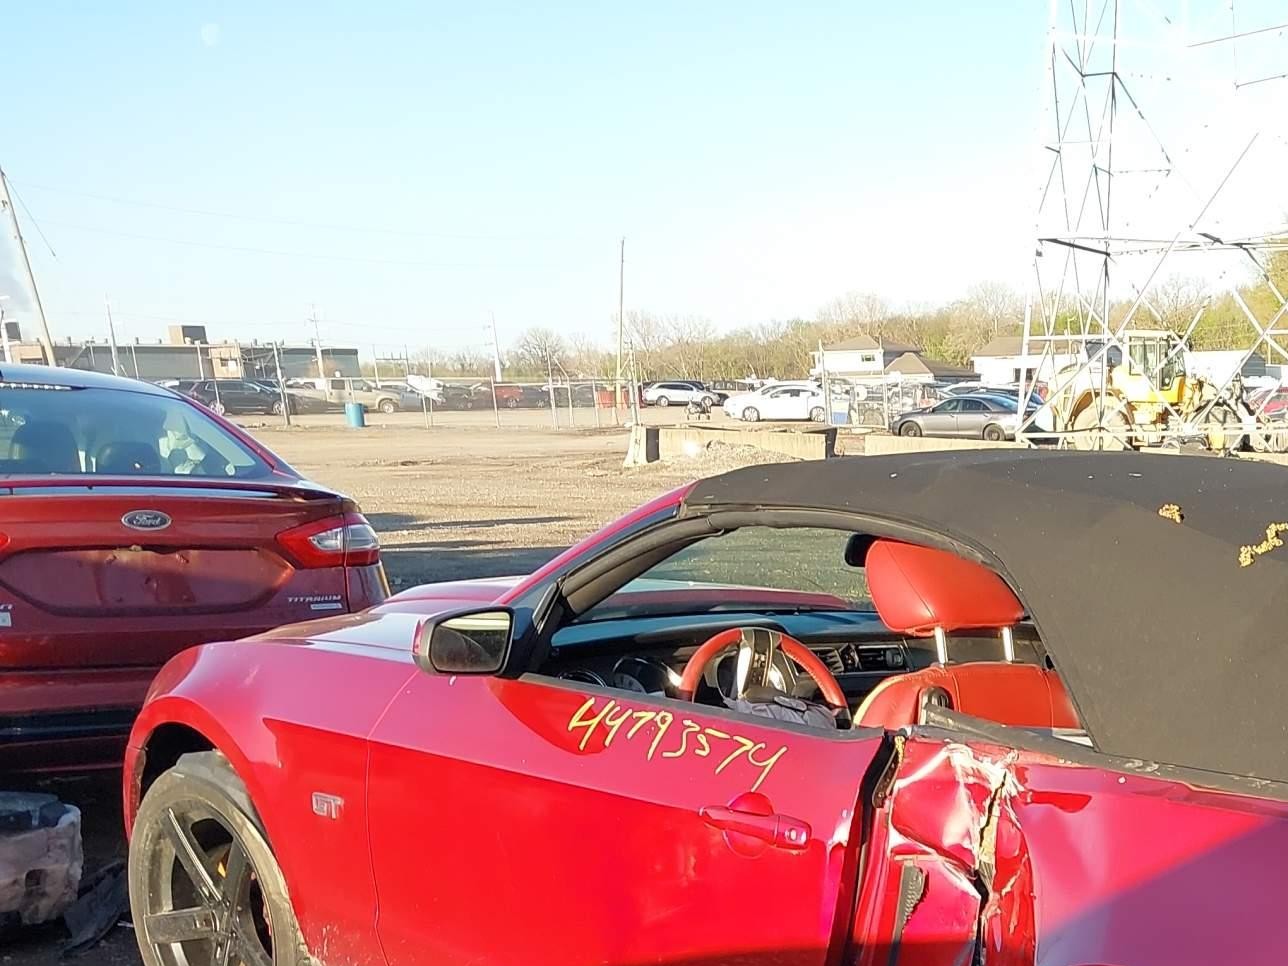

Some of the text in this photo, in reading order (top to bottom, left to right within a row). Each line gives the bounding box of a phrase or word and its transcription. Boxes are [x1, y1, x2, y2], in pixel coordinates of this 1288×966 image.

[288, 594, 342, 603] TITANIUM
[567, 696, 788, 792] 44793574
[311, 791, 345, 820] GT
